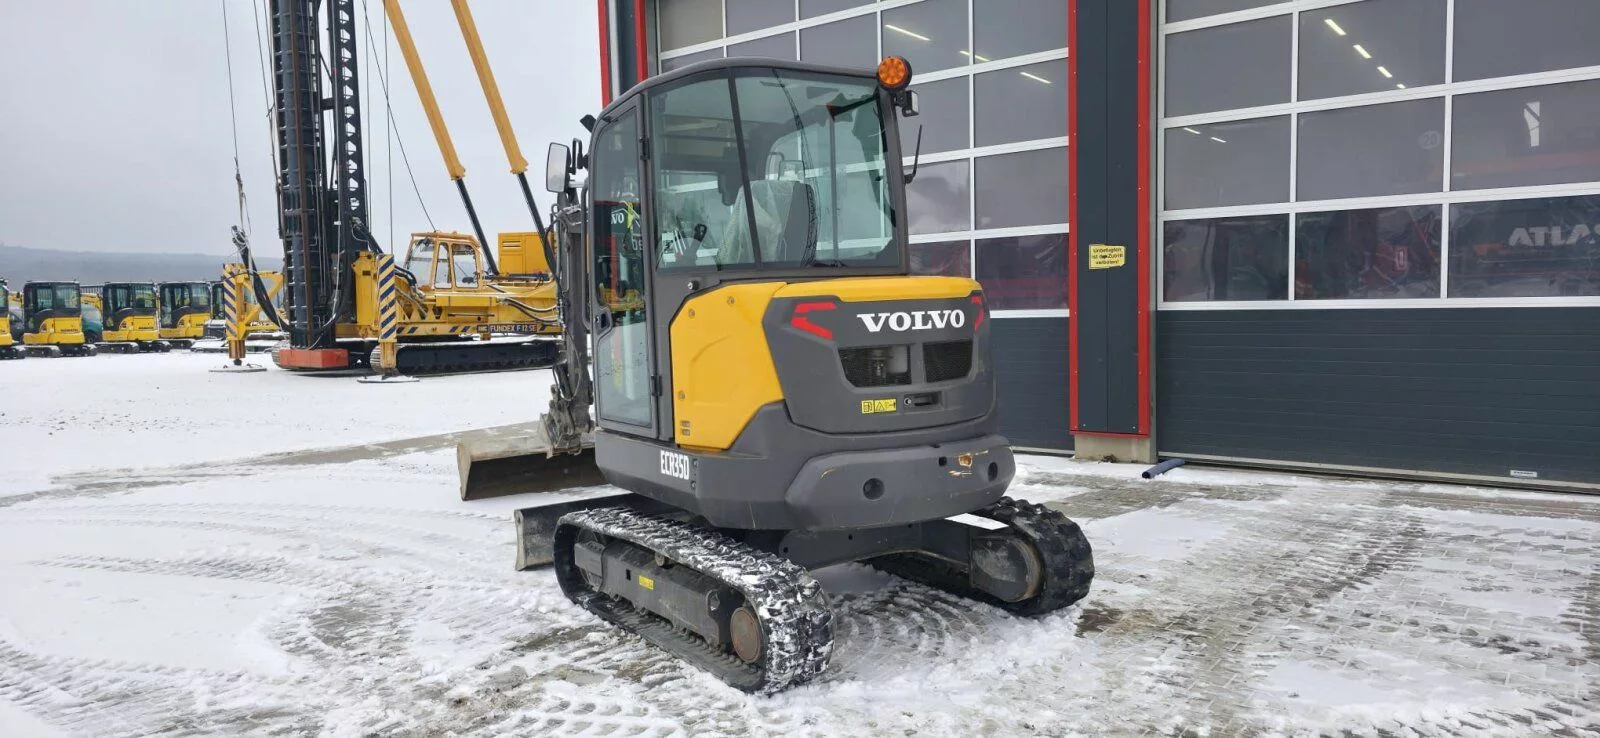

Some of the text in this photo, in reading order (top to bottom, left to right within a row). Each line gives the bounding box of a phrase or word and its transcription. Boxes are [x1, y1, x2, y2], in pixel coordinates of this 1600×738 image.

[490, 324, 515, 332] FUNDEX
[516, 324, 521, 332] F
[857, 309, 965, 332] VOLVO
[660, 450, 690, 480] ECR35D
